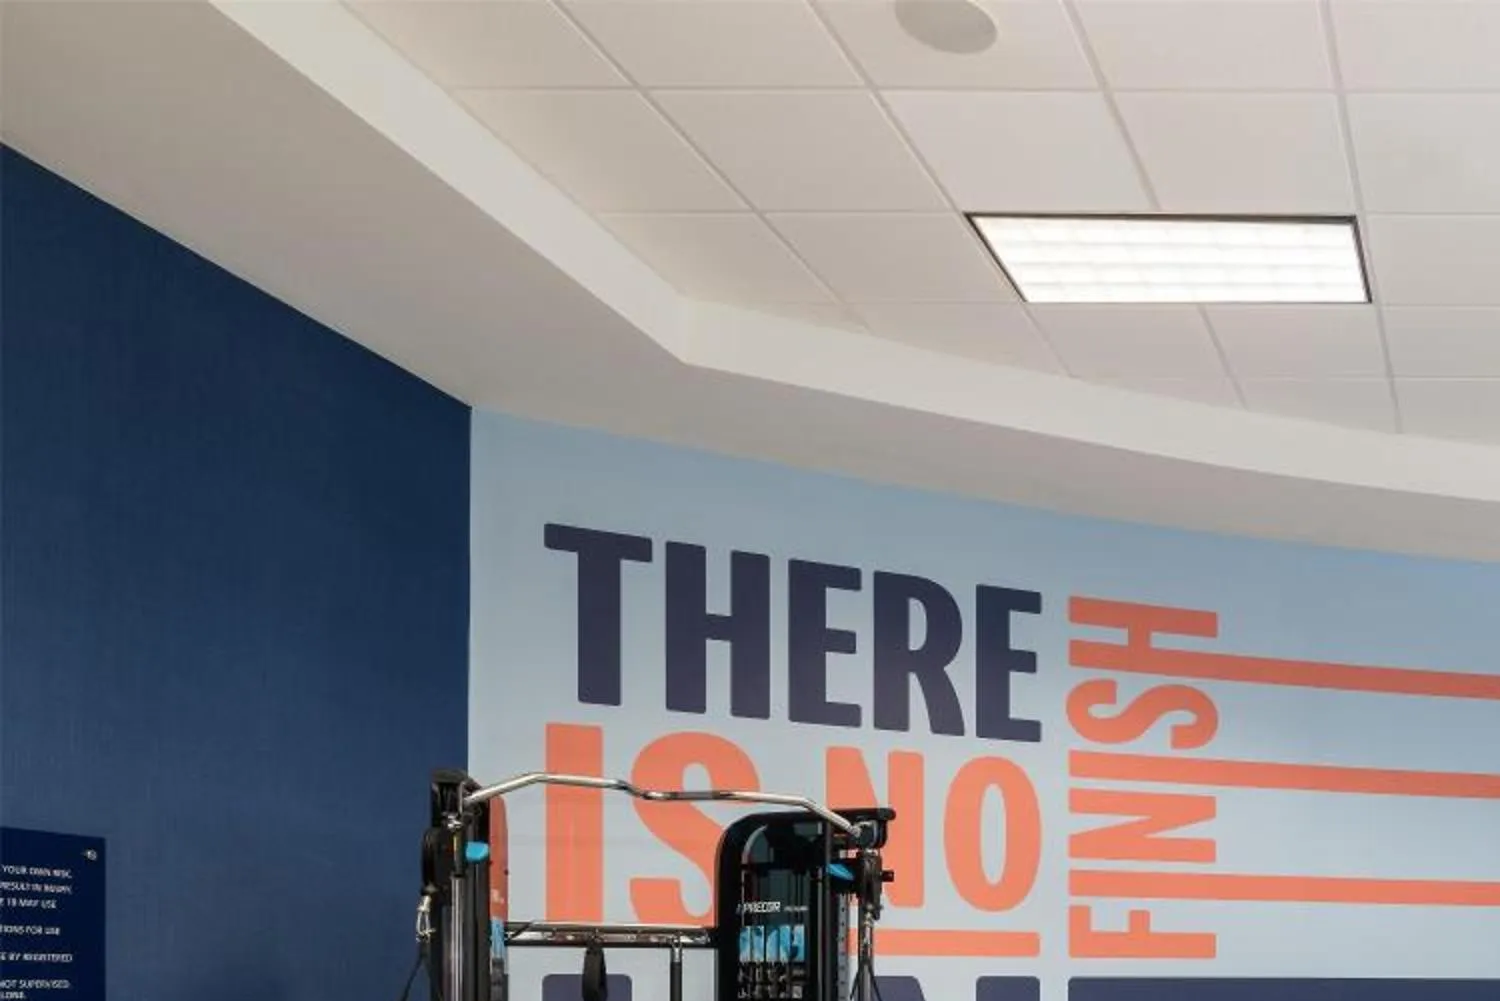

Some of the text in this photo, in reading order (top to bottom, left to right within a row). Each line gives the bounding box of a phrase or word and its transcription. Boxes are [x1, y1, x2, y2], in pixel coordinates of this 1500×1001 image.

[543, 522, 1042, 743] THERE
[544, 721, 1042, 928] IS NO
[1065, 596, 1220, 960] FINISH
